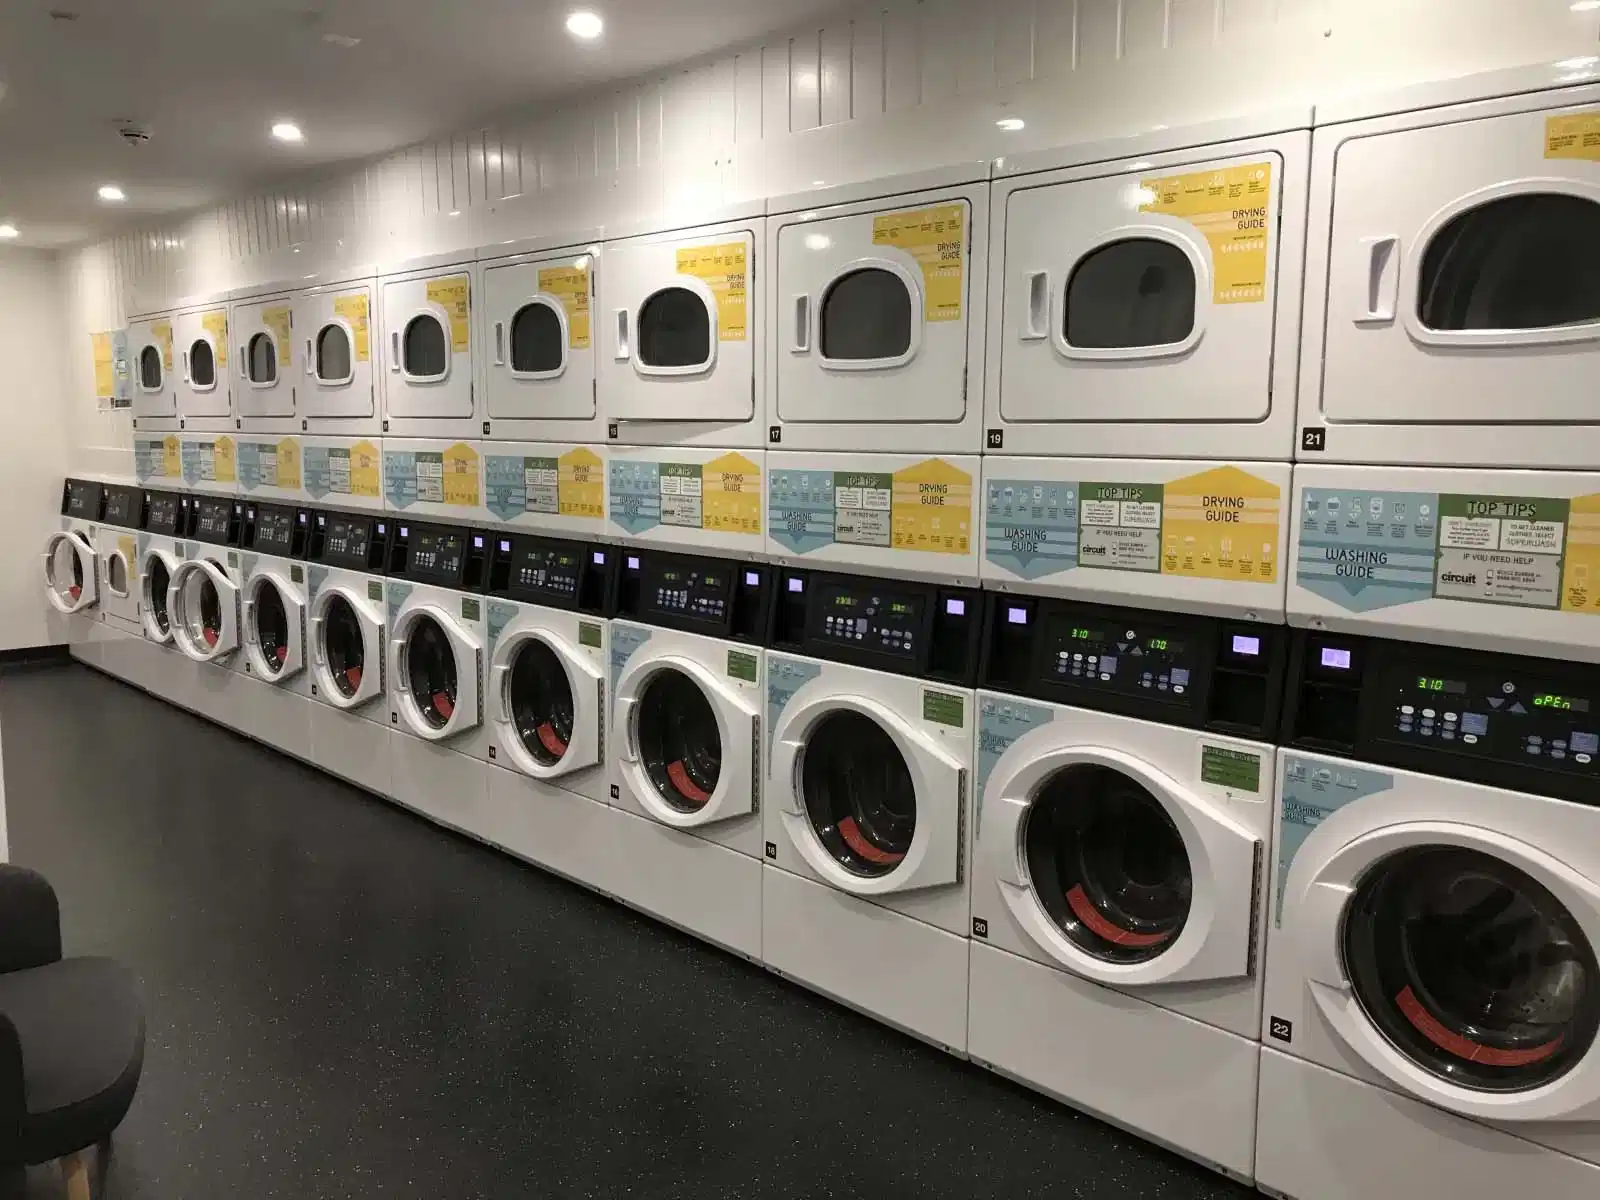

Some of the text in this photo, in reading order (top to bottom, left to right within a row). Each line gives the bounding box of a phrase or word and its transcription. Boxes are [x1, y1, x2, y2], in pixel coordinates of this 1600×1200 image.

[1232, 207, 1266, 219] DRYING
[1237, 219, 1265, 230] GUIDE
[937, 240, 960, 251] DRYING
[771, 430, 779, 439] 17
[989, 434, 1001, 444] 19
[1305, 433, 1321, 445] 21
[919, 483, 948, 494] DRYING
[1096, 487, 1144, 500] TOP TIPS
[921, 495, 945, 506] GUIDE
[1202, 496, 1244, 509] DRYING
[1467, 501, 1537, 517] TOP TIPS
[781, 511, 812, 521] WASHING
[1205, 511, 1240, 523] GUIDE
[786, 521, 807, 532] GUIDE
[1004, 527, 1047, 541] WASHING
[1011, 540, 1039, 552] GUIDE
[1082, 544, 1106, 555] circuit
[1325, 547, 1388, 565] WASHING
[1463, 553, 1535, 565] IF YOU NEED HELP
[1335, 564, 1375, 579] GUIDE
[1441, 571, 1476, 584] circuit
[975, 922, 986, 933] 20
[1273, 1022, 1289, 1037] 22
